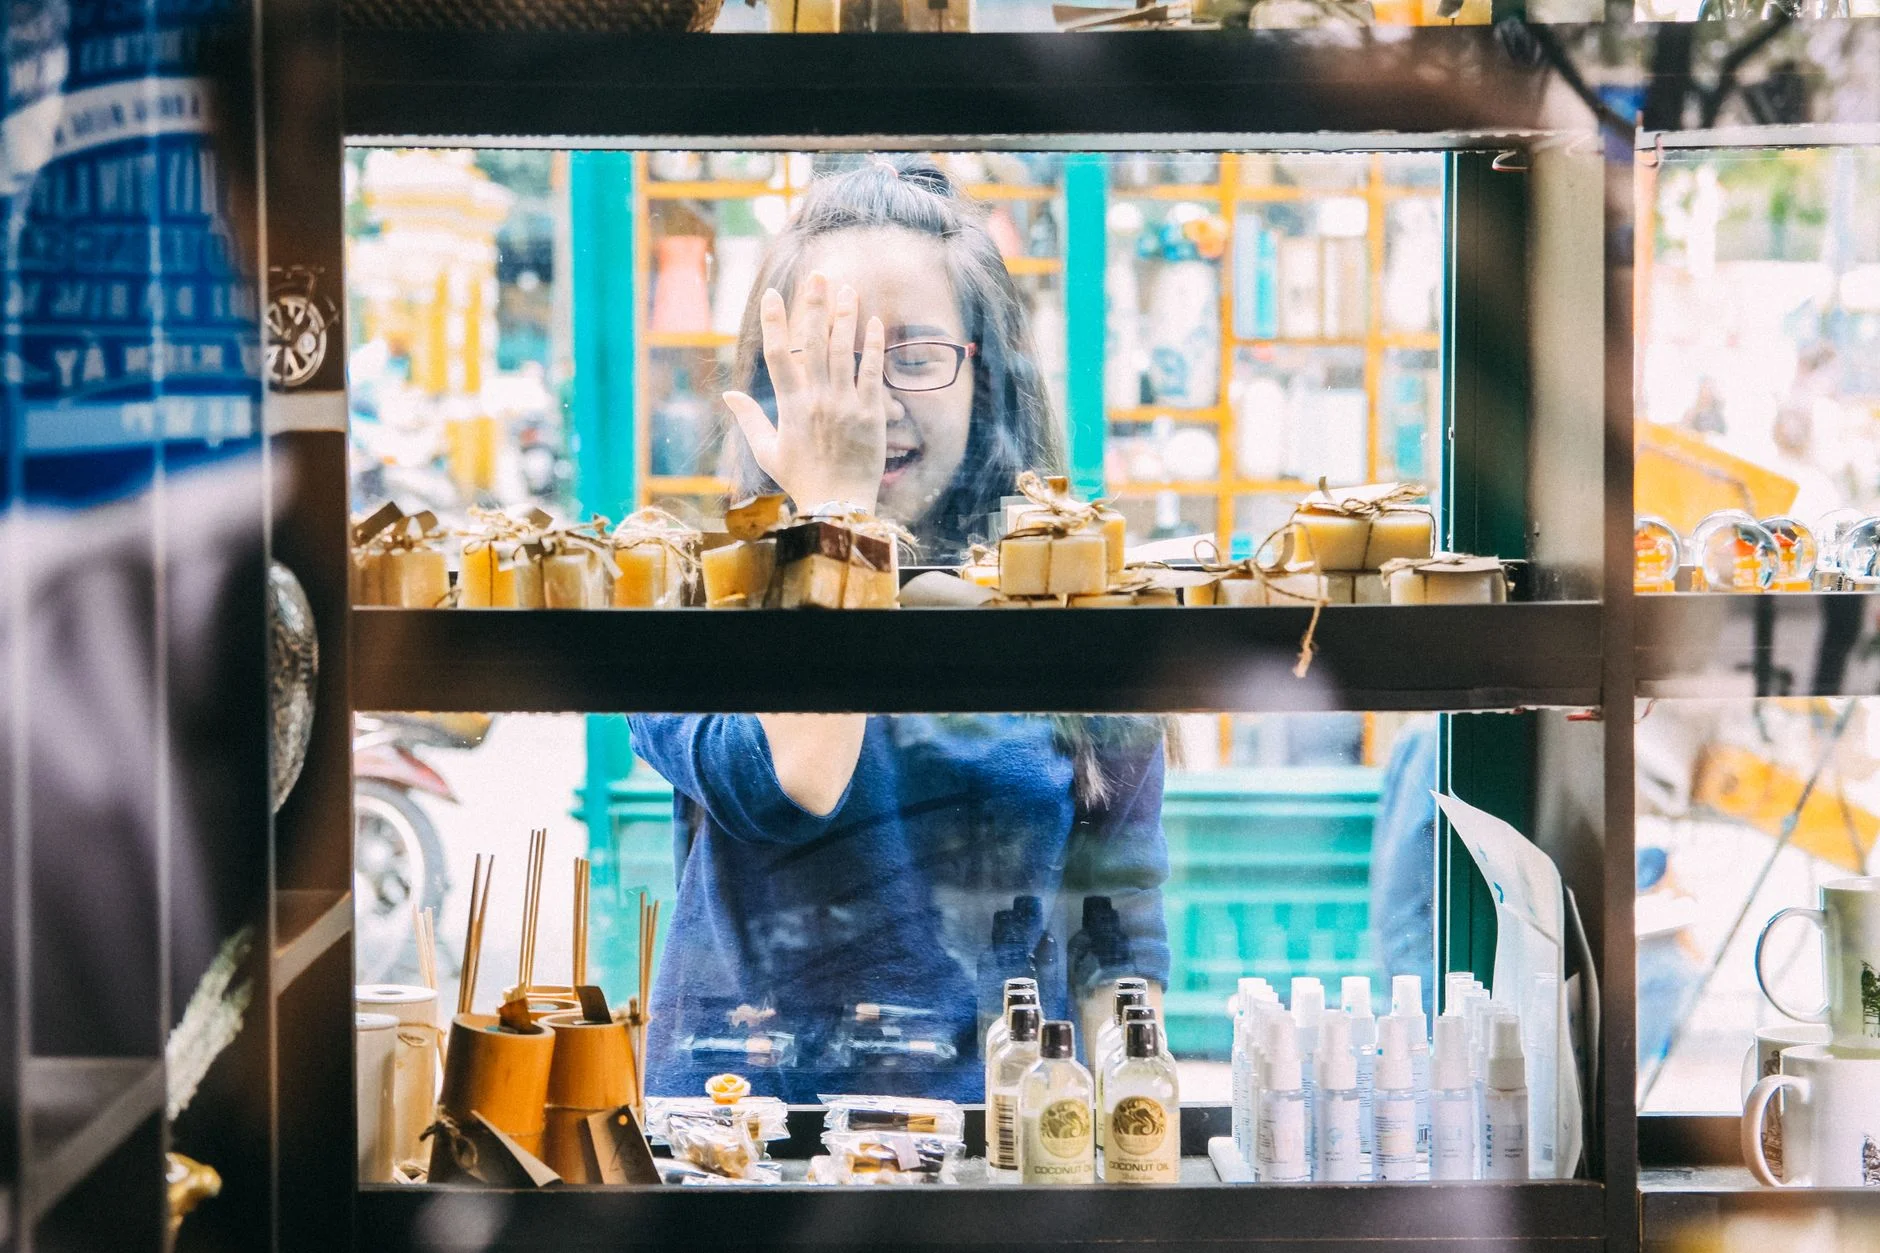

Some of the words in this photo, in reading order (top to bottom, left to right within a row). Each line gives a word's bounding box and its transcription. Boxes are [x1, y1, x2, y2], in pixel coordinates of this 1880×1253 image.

[1034, 1166, 1082, 1175] COCONUT
[1109, 1161, 1153, 1172] COCONUT
[1156, 1161, 1169, 1172] OIL
